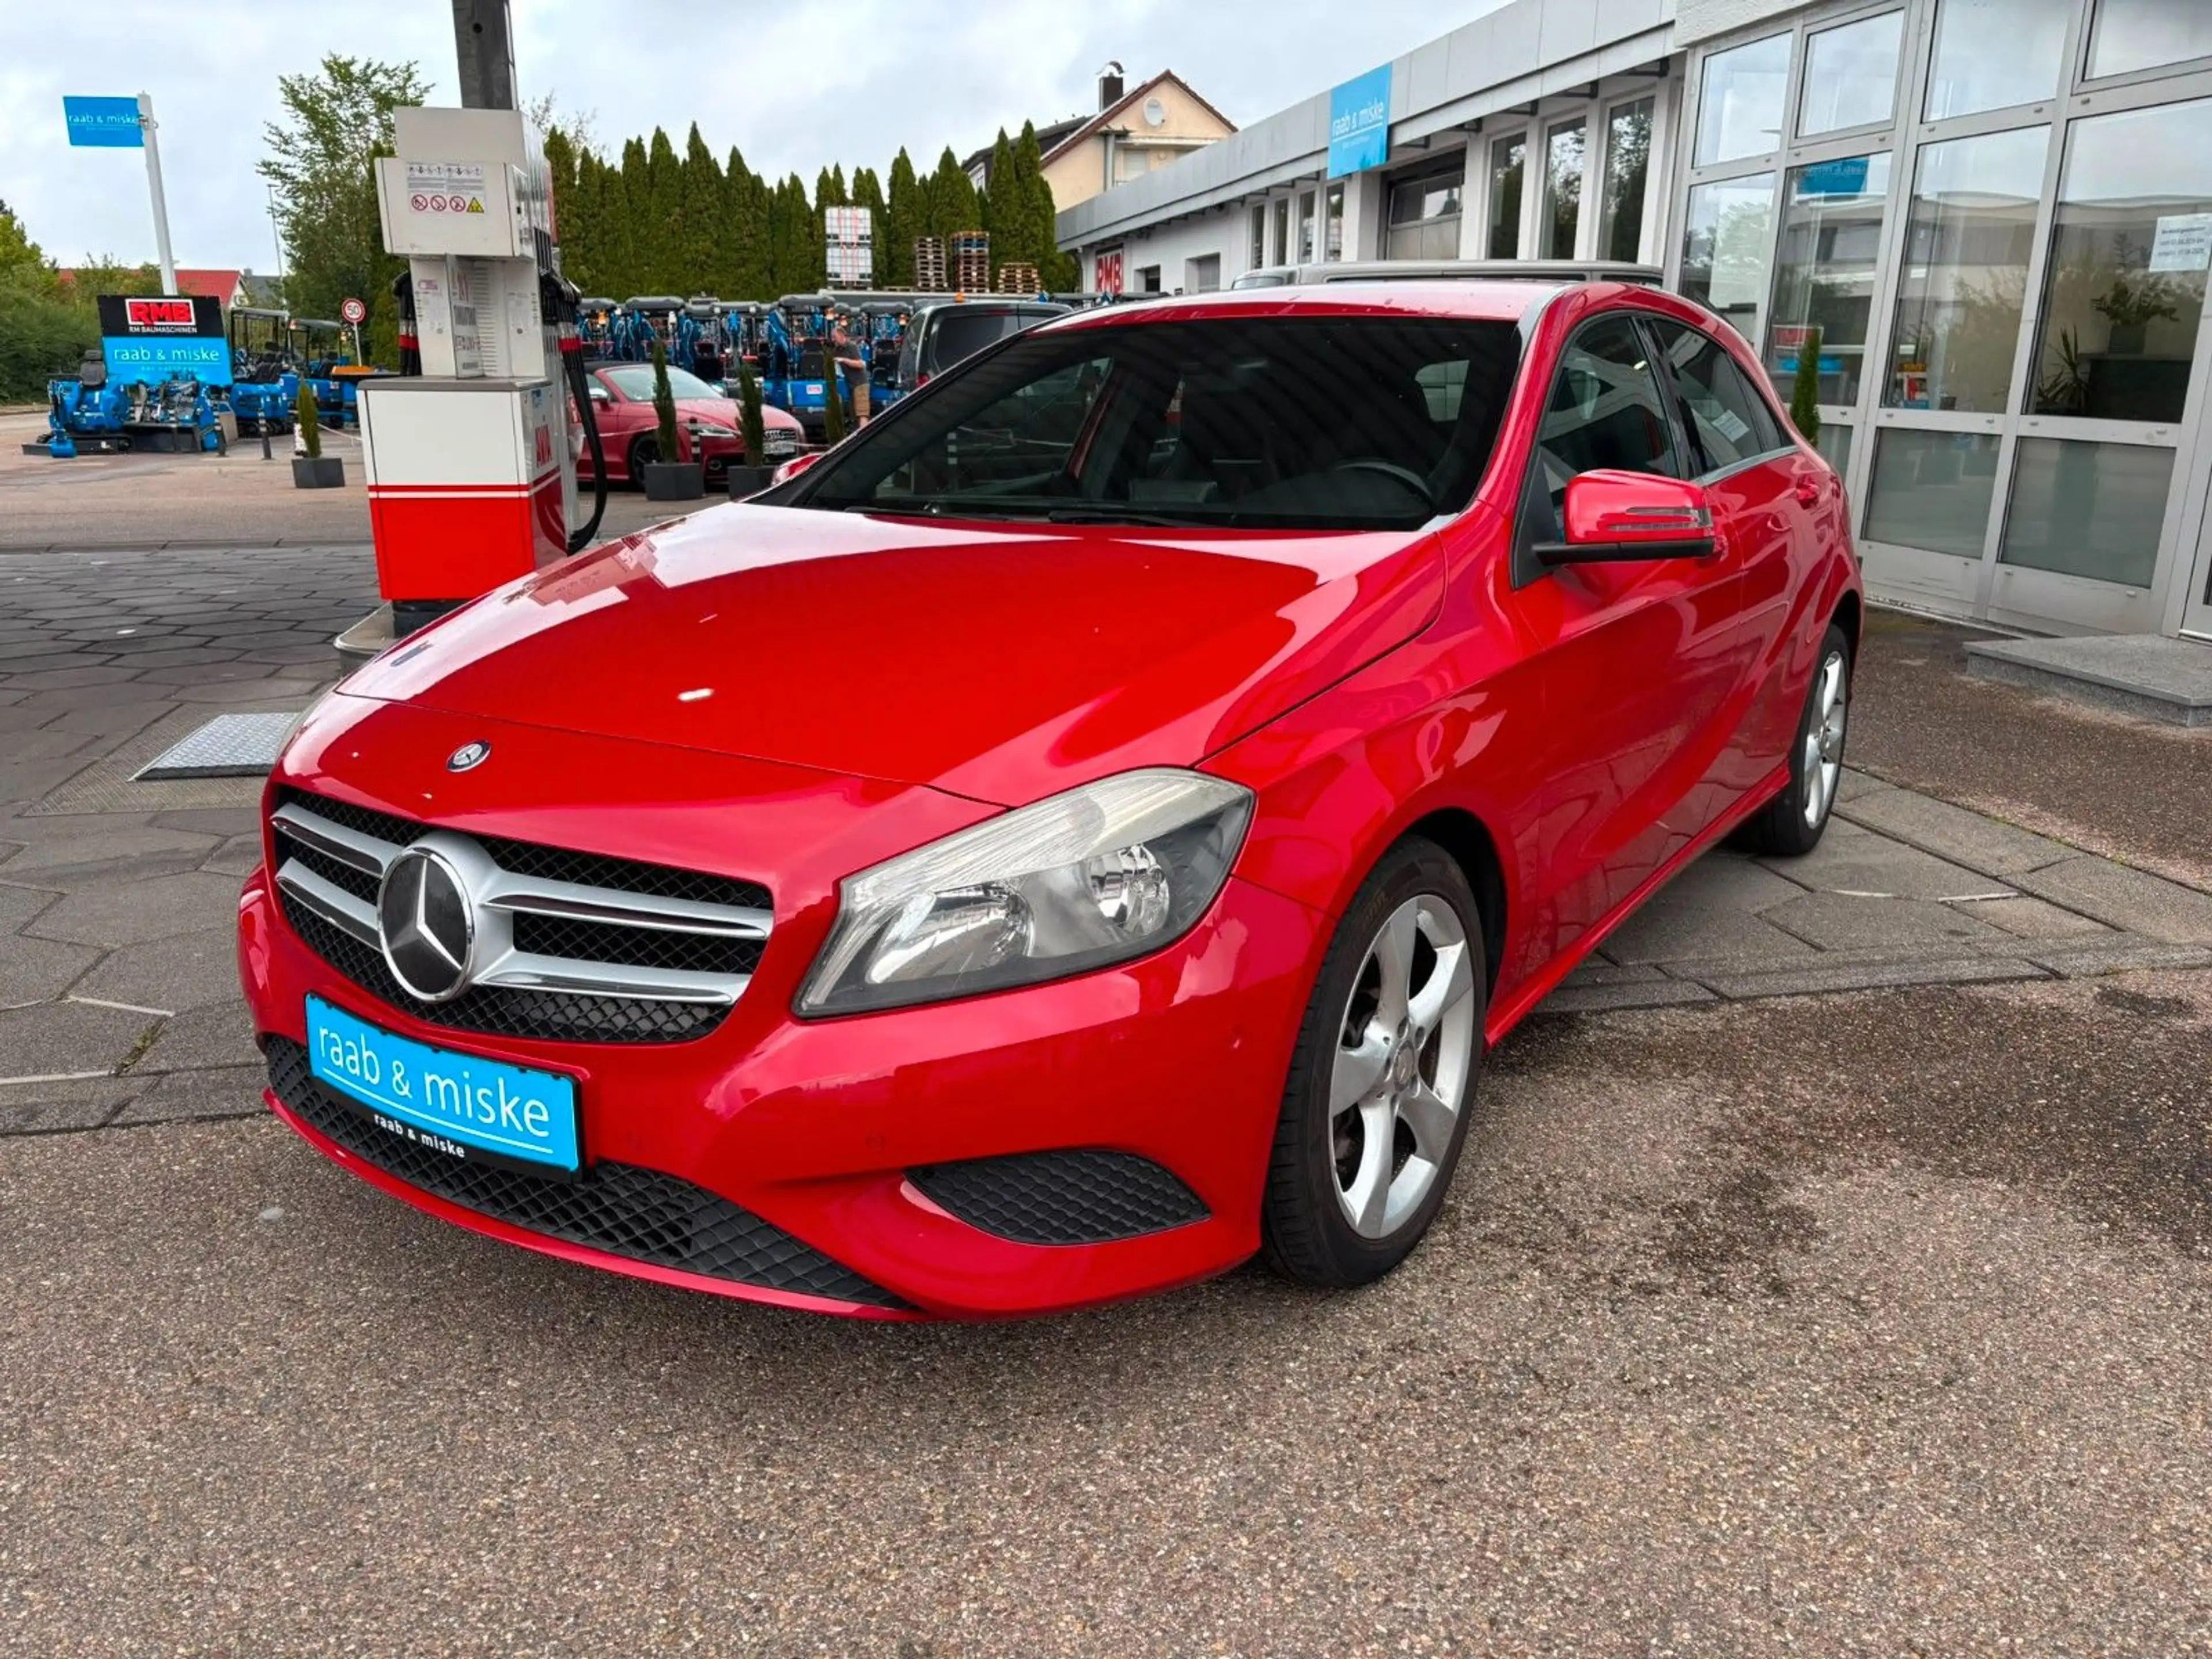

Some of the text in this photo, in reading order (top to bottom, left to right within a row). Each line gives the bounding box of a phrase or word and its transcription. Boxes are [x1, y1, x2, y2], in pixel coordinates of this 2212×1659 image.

[69, 112, 93, 123] raab
[107, 113, 137, 124] miske
[1332, 108, 1350, 137] raab
[1096, 252, 1123, 295] RMB
[129, 302, 191, 327] RMB
[347, 305, 359, 316] 50
[114, 346, 219, 361] raab & miske
[319, 1027, 550, 1138] raab & miske
[373, 1113, 465, 1158] raab & miske
